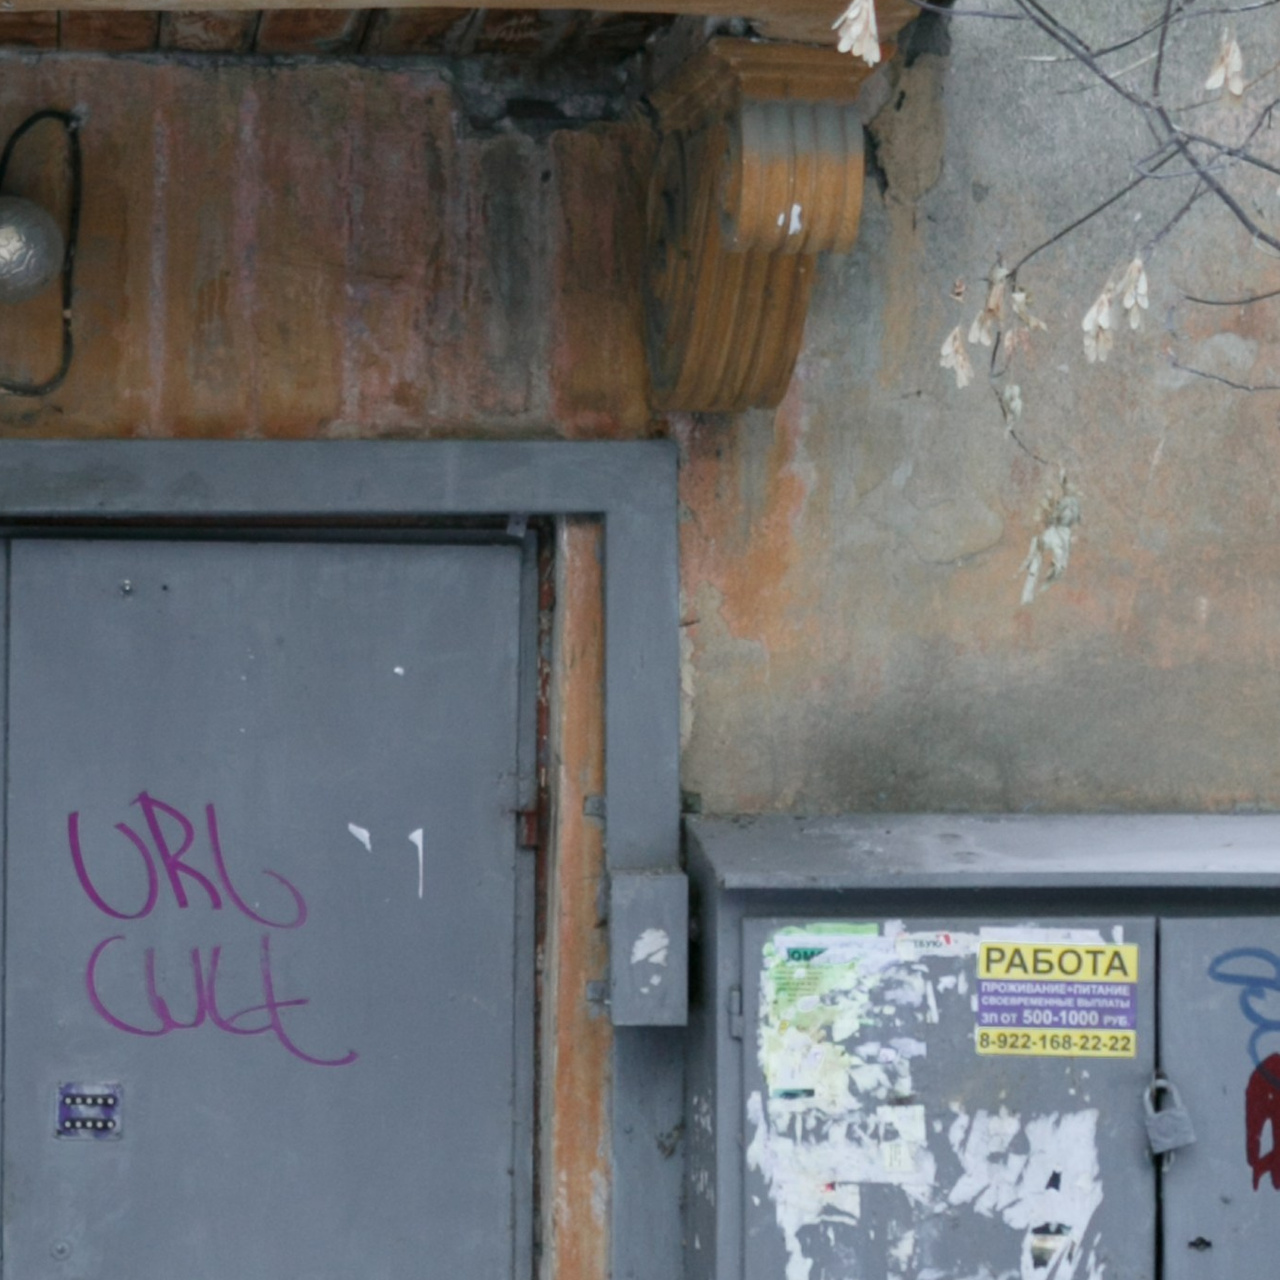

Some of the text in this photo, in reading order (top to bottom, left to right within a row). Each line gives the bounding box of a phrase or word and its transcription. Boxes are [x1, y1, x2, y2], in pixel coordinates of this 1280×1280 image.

[984, 946, 1129, 978] РАБОТА
[981, 996, 1130, 1009] СВОЕВРЕМЕННЫЕ ВЫПЛАТЫ
[981, 1012, 998, 1024] ЗП
[1000, 1012, 1017, 1024] ОТ
[1022, 1009, 1099, 1026] 500-1000
[979, 1032, 1131, 1052] 8-922-168-22-22
